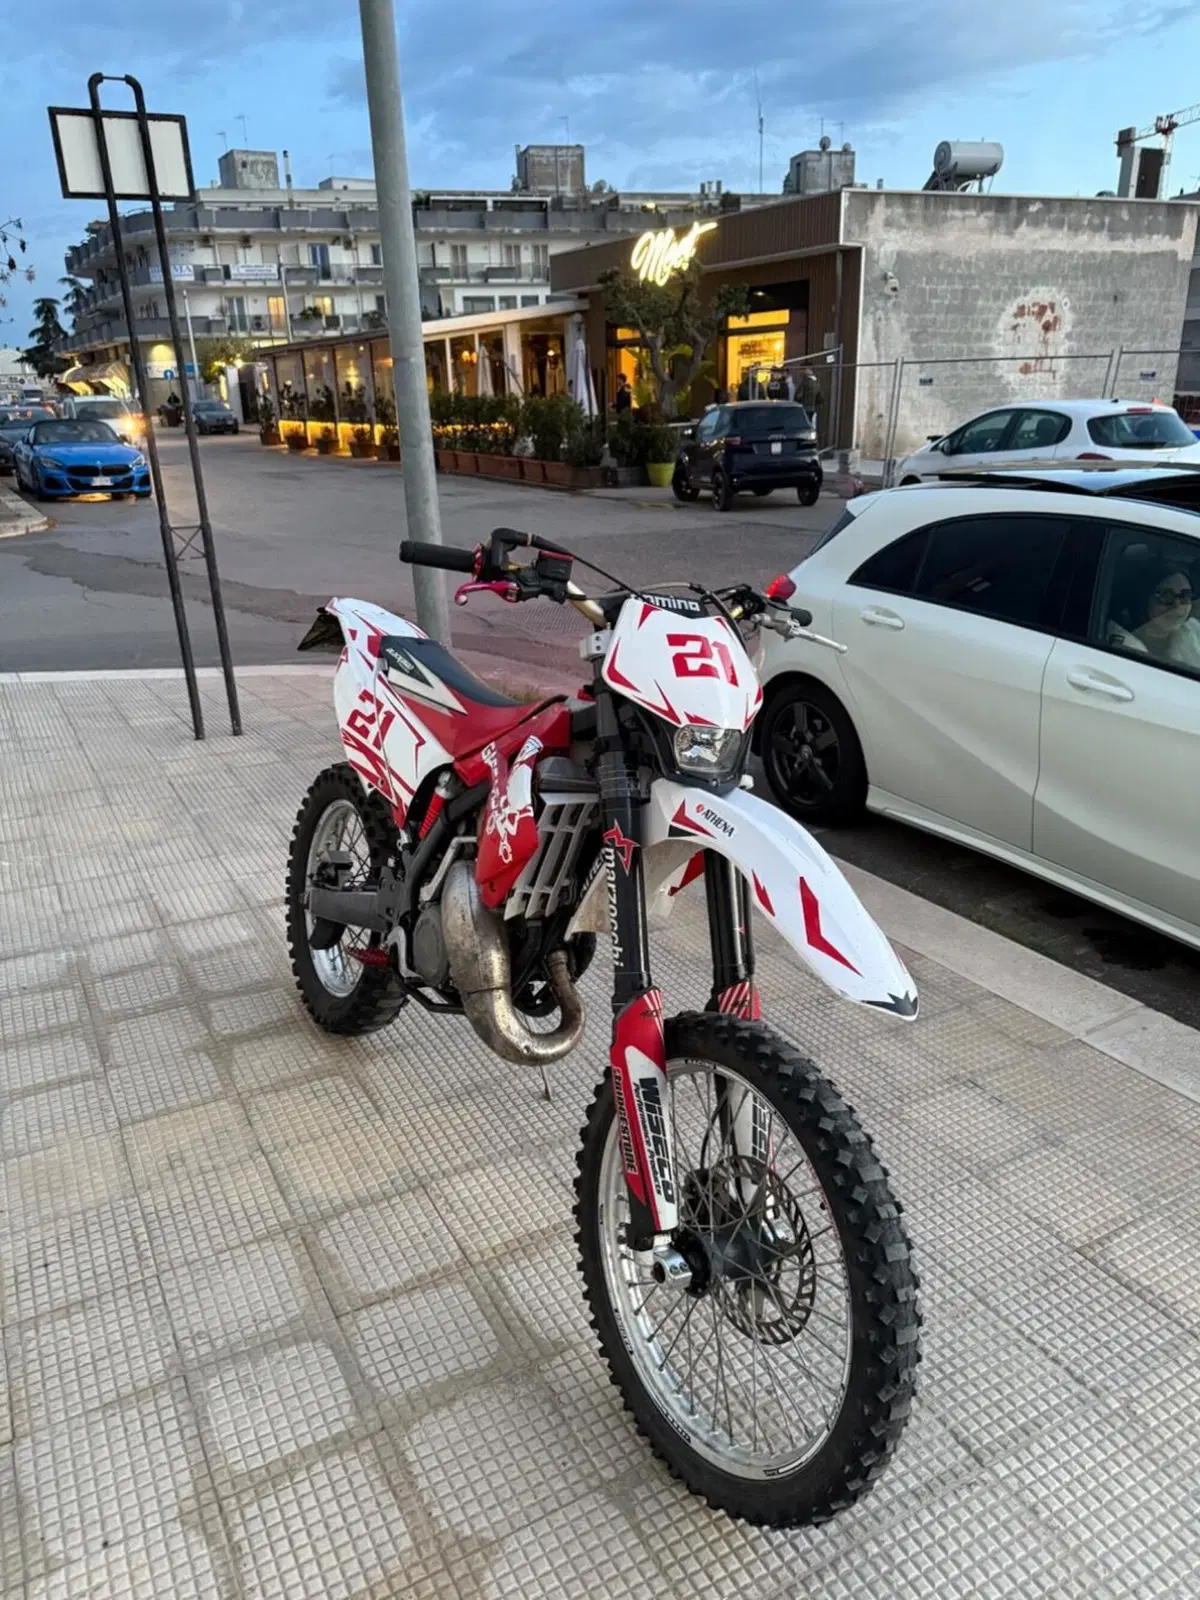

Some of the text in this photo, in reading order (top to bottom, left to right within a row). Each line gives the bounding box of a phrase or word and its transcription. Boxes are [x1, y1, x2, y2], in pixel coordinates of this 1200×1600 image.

[665, 633, 739, 688] 21
[346, 689, 396, 751] 21
[701, 808, 735, 837] ATHENA
[601, 847, 624, 968] marzocchi
